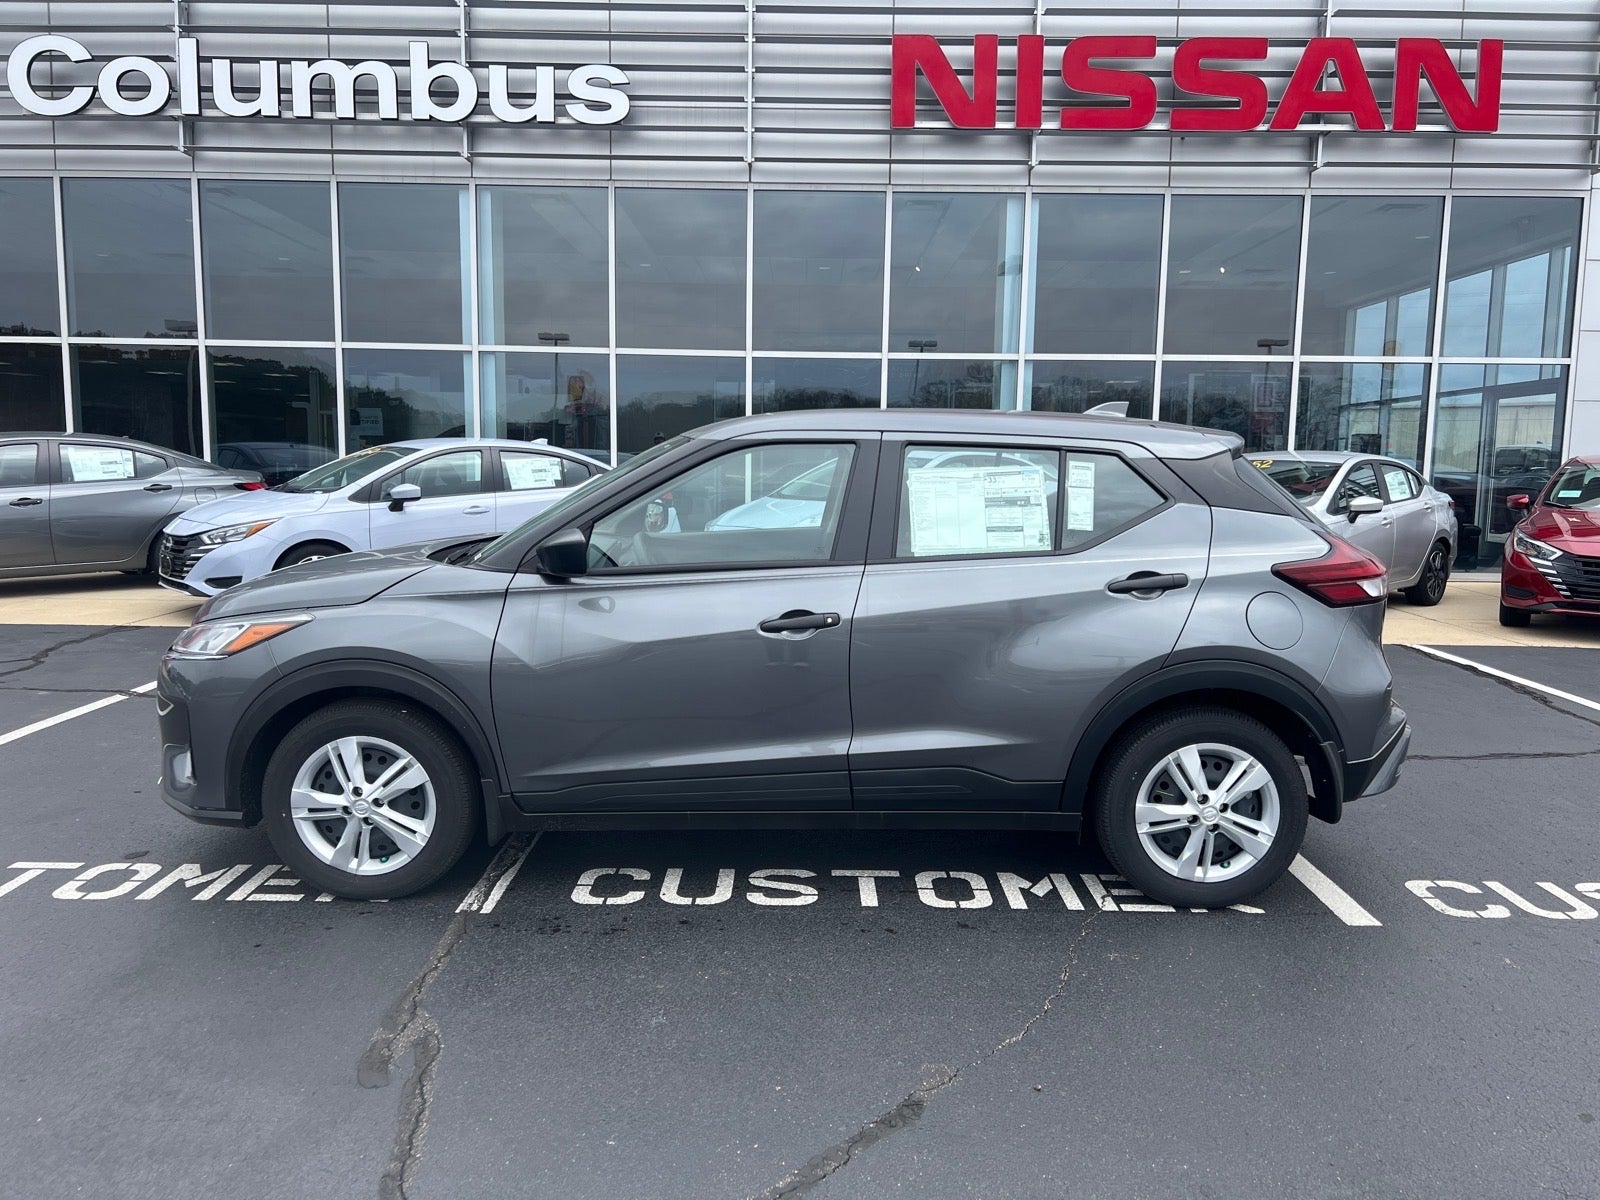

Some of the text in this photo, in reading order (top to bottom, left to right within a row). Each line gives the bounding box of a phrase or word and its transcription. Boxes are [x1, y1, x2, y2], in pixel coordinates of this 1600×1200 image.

[6, 34, 631, 126] Columbus
[890, 34, 1504, 133] NISSAN
[0, 861, 390, 903] TOME
[571, 867, 1266, 914] CUSTOME
